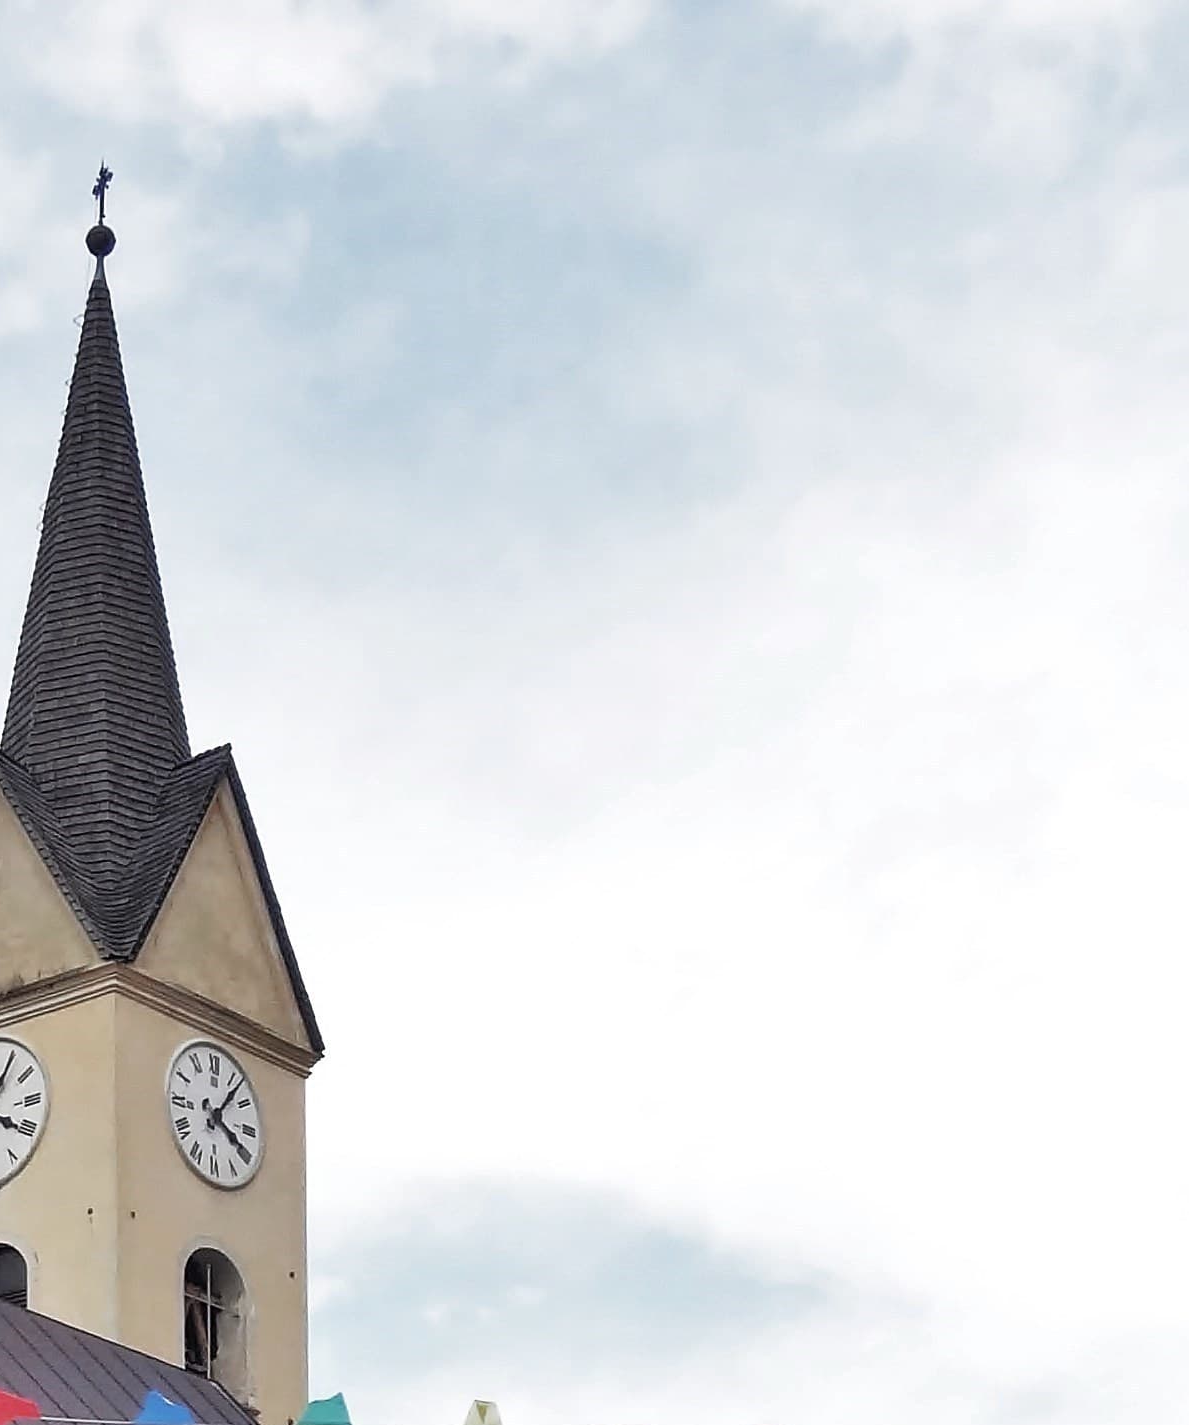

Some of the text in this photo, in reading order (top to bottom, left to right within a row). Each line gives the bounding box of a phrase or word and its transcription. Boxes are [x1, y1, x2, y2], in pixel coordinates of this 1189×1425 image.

[17, 1065, 34, 1084] II
[24, 1092, 42, 1107] III
[237, 1098, 251, 1109] II
